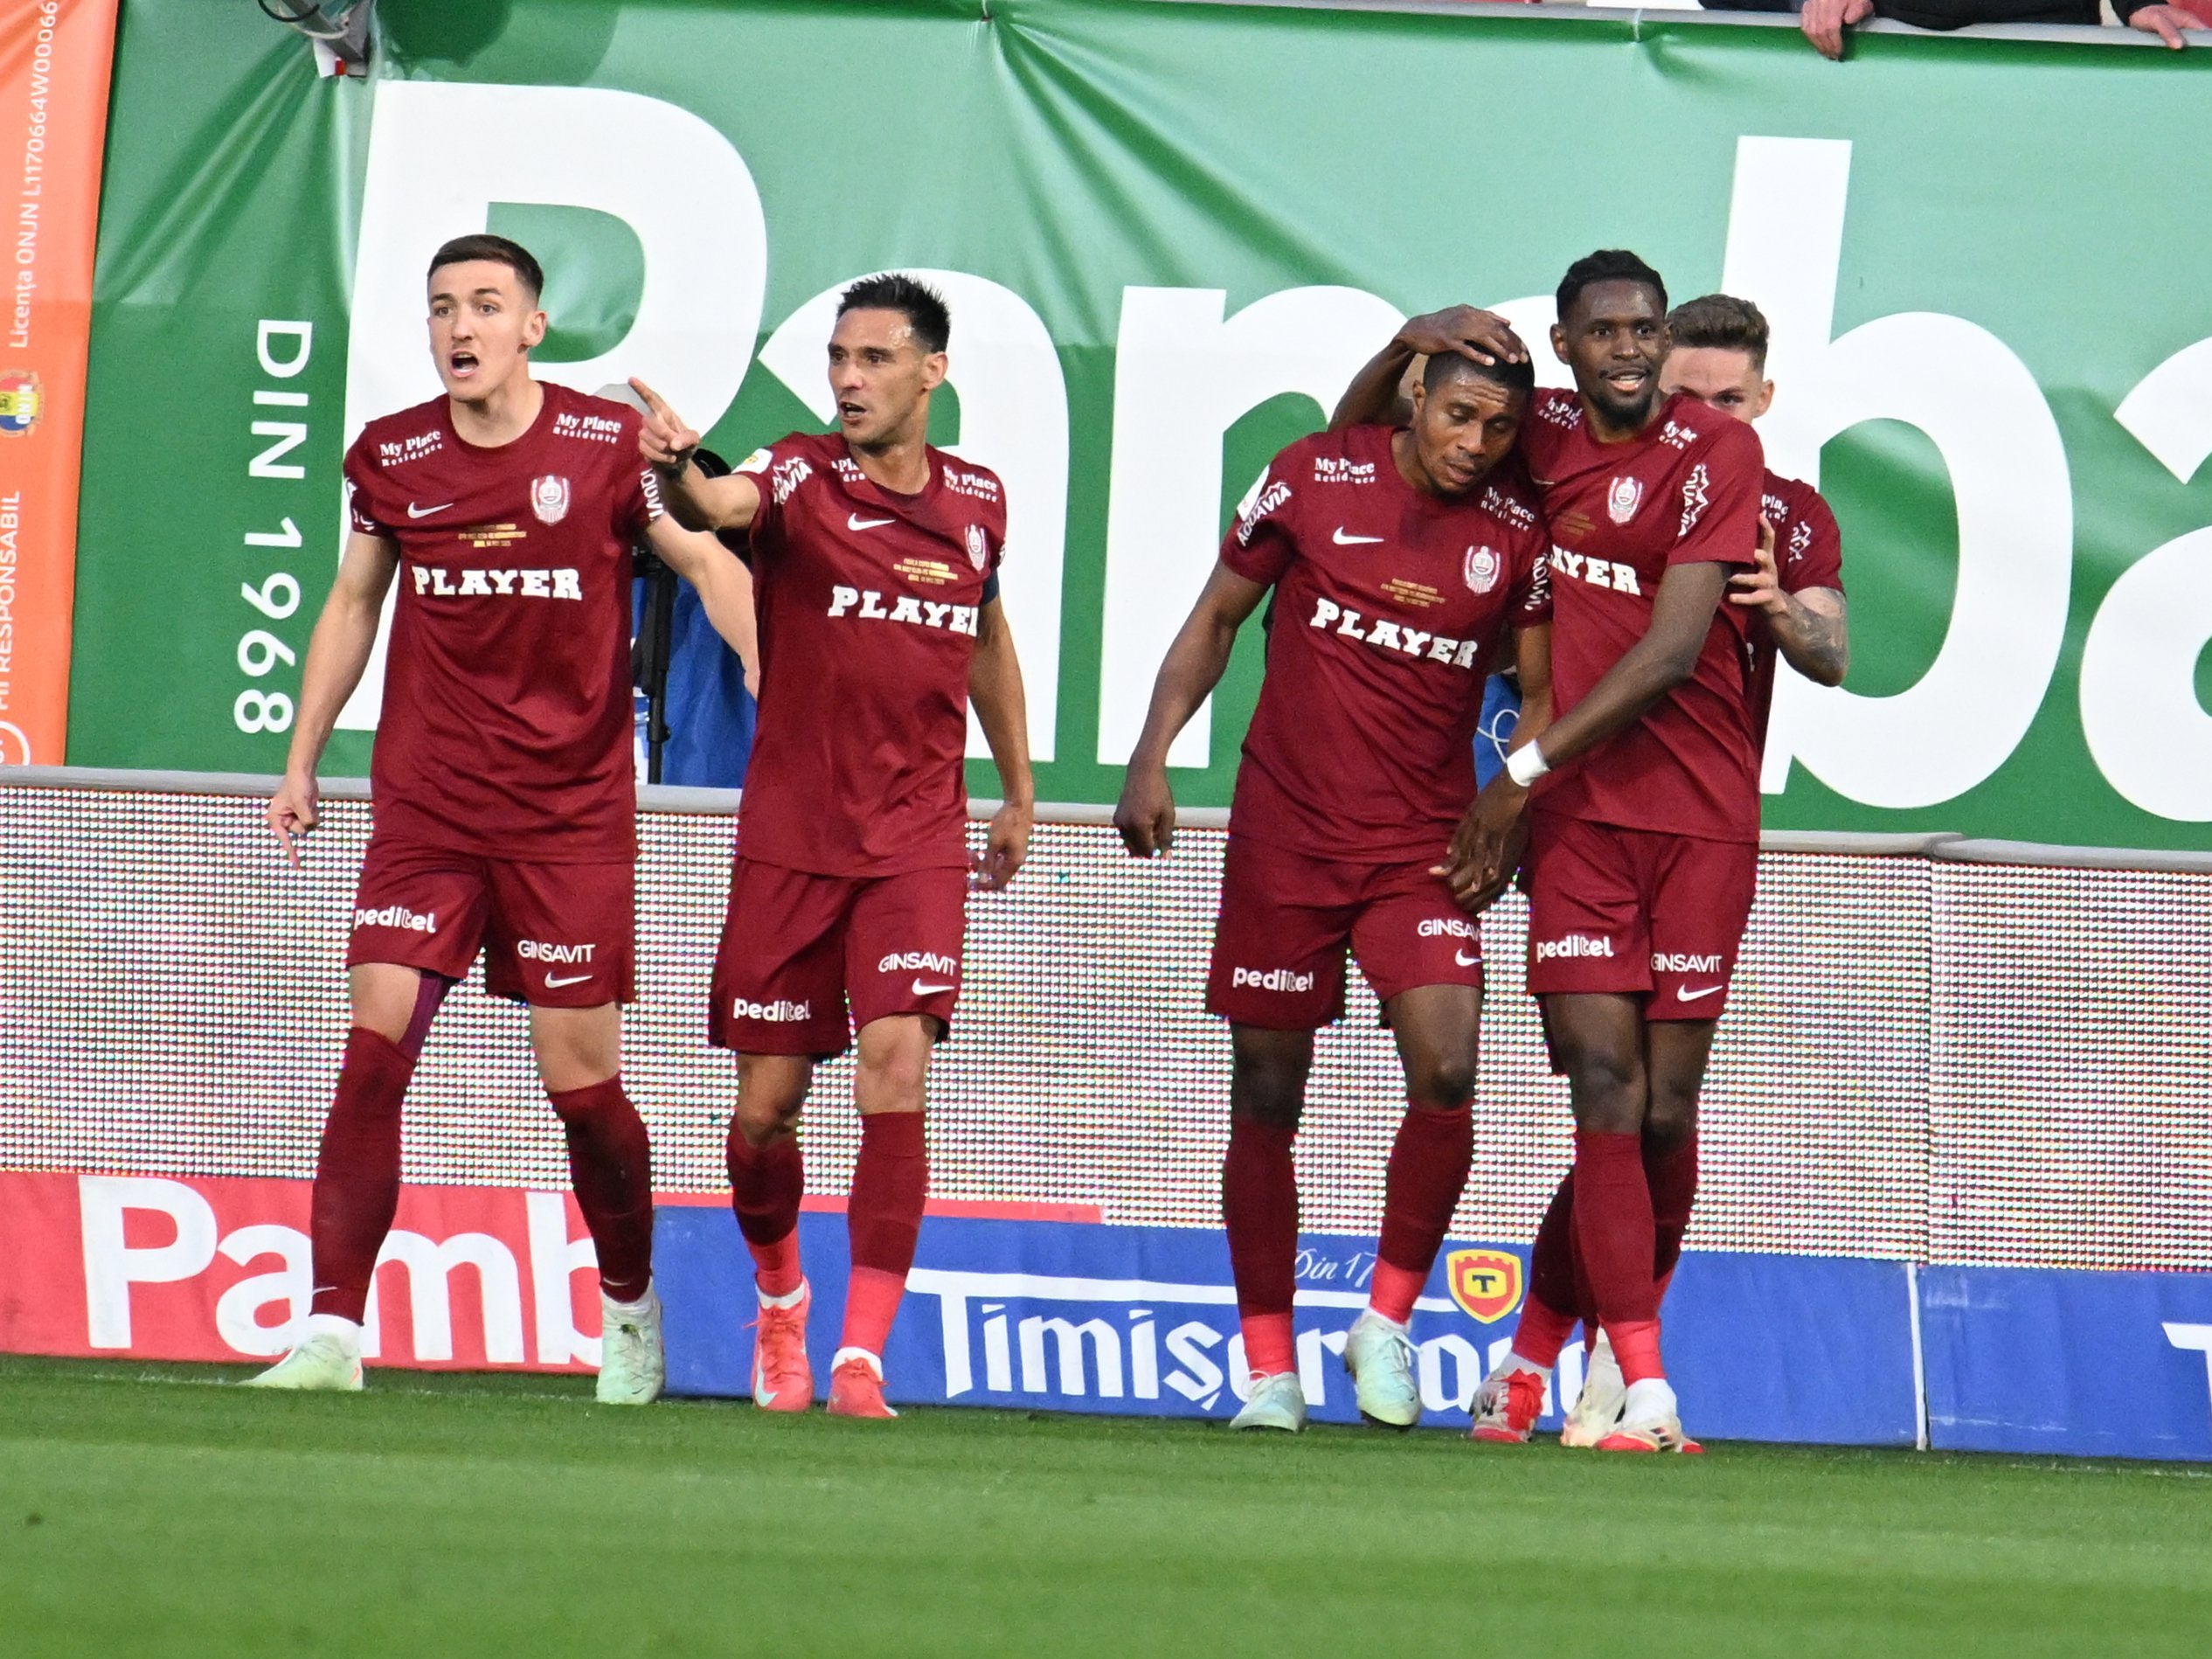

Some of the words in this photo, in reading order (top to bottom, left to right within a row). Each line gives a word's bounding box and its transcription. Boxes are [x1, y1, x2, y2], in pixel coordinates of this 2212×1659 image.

[16, 203, 40, 264] ONJN
[249, 319, 313, 480] DIN
[557, 413, 581, 429] My
[582, 415, 621, 434] Place
[379, 442, 402, 456] My
[406, 430, 440, 451] Place
[381, 442, 442, 467] Residence
[1314, 457, 1337, 474] My
[1339, 457, 1375, 475] Place
[961, 474, 997, 492] Place
[412, 566, 583, 600] PLAYER
[1550, 544, 1641, 596] AYER
[233, 517, 302, 734] 1968
[1309, 597, 1479, 670] PLAYER
[353, 906, 436, 933] peditel
[1417, 919, 1480, 941] GINSAV
[517, 940, 596, 963] GINSAVIT
[1536, 935, 1614, 961] peditel
[878, 951, 957, 976] GINSAVIT
[1651, 953, 1723, 973] GINSAVIT
[1232, 967, 1314, 993] peditel
[732, 996, 811, 1022] peditel
[1293, 1248, 1336, 1281] Din
